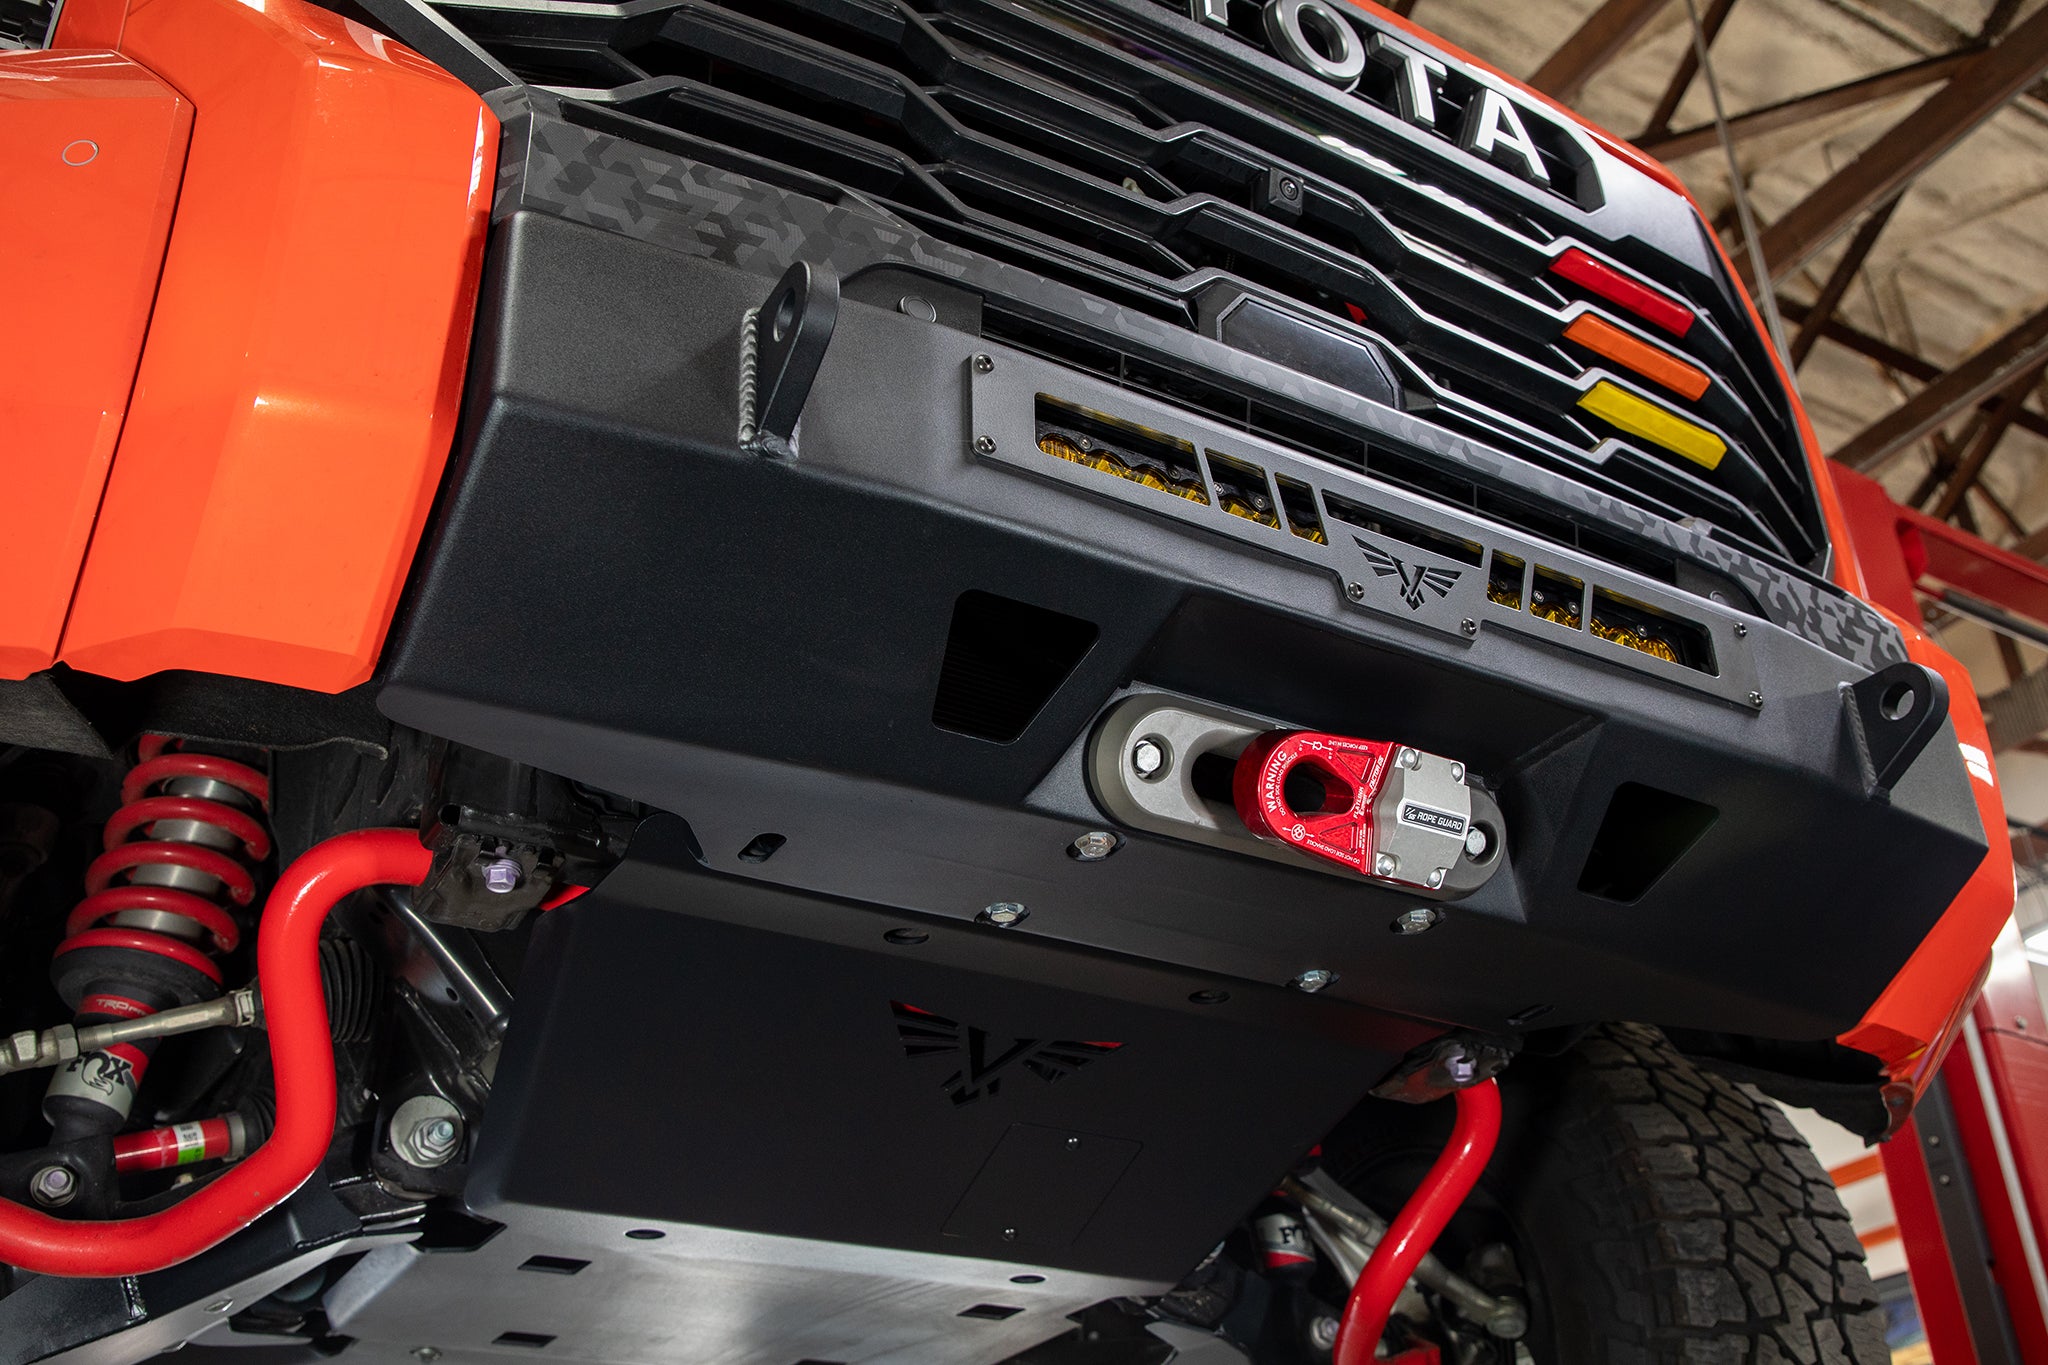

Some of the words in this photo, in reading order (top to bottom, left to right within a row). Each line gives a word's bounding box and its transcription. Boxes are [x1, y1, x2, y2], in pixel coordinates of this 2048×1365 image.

[1266, 751, 1287, 813] WARNING
[1369, 764, 1381, 789] FACTOR
[1353, 786, 1364, 819] FLATLINK
[1417, 811, 1437, 824] ROPE
[1438, 817, 1463, 830] GUARD
[1324, 846, 1336, 855] LOAD
[96, 999, 129, 1011] TRD
